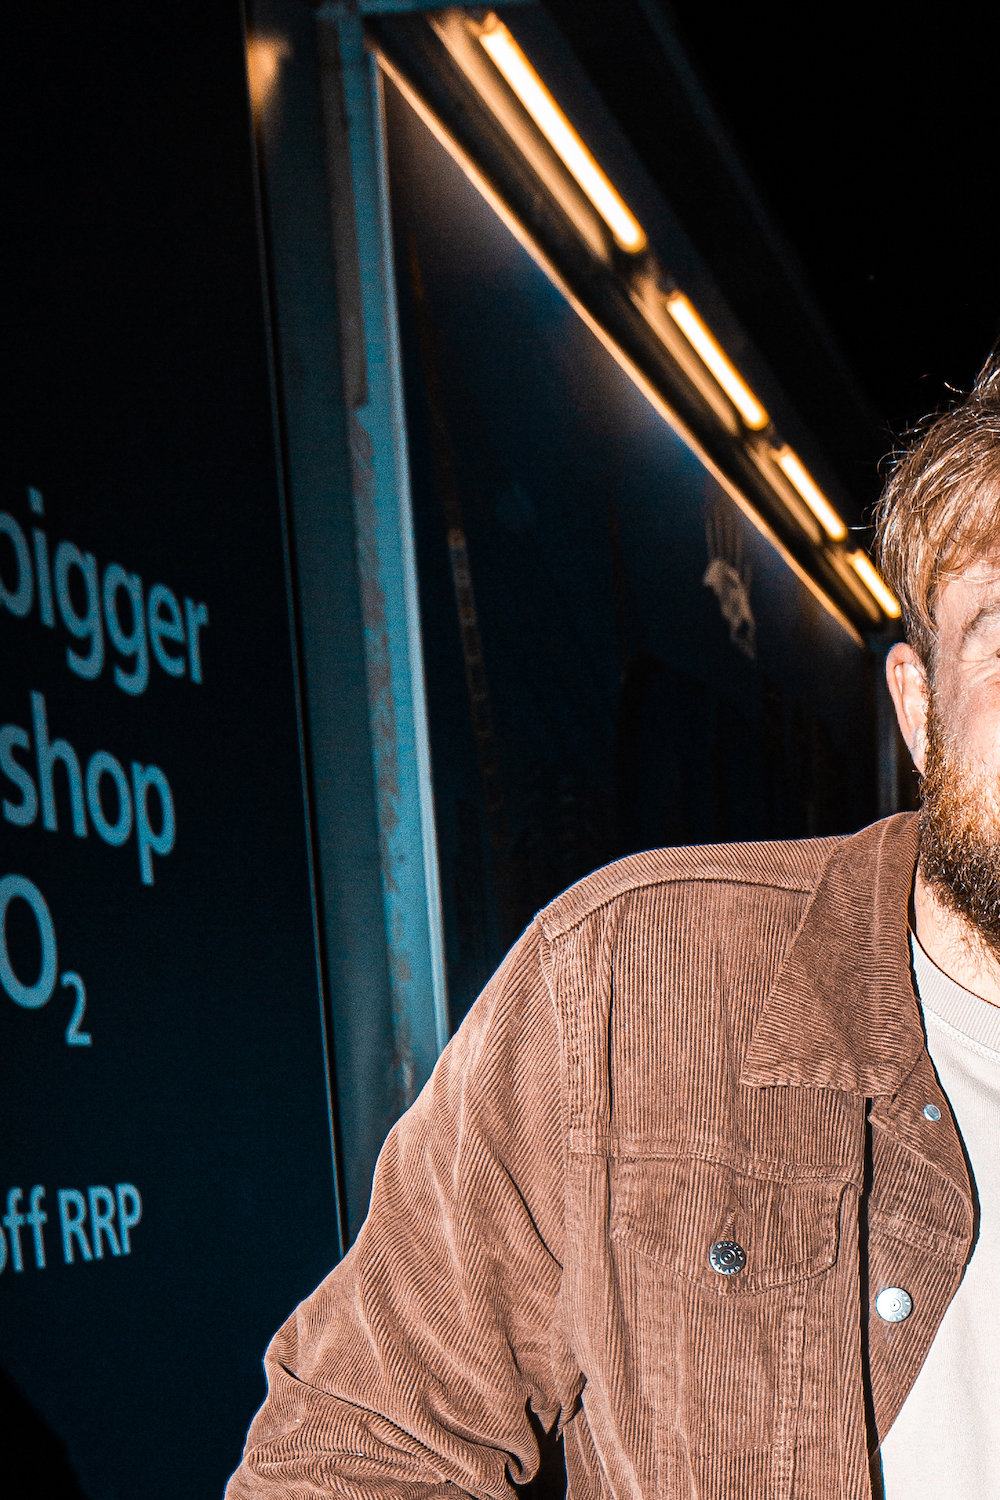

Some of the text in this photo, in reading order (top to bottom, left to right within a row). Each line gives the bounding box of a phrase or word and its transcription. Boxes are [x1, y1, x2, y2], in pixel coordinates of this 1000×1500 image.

[0, 690, 176, 886] shop
[0, 1182, 142, 1274] ff RRP
